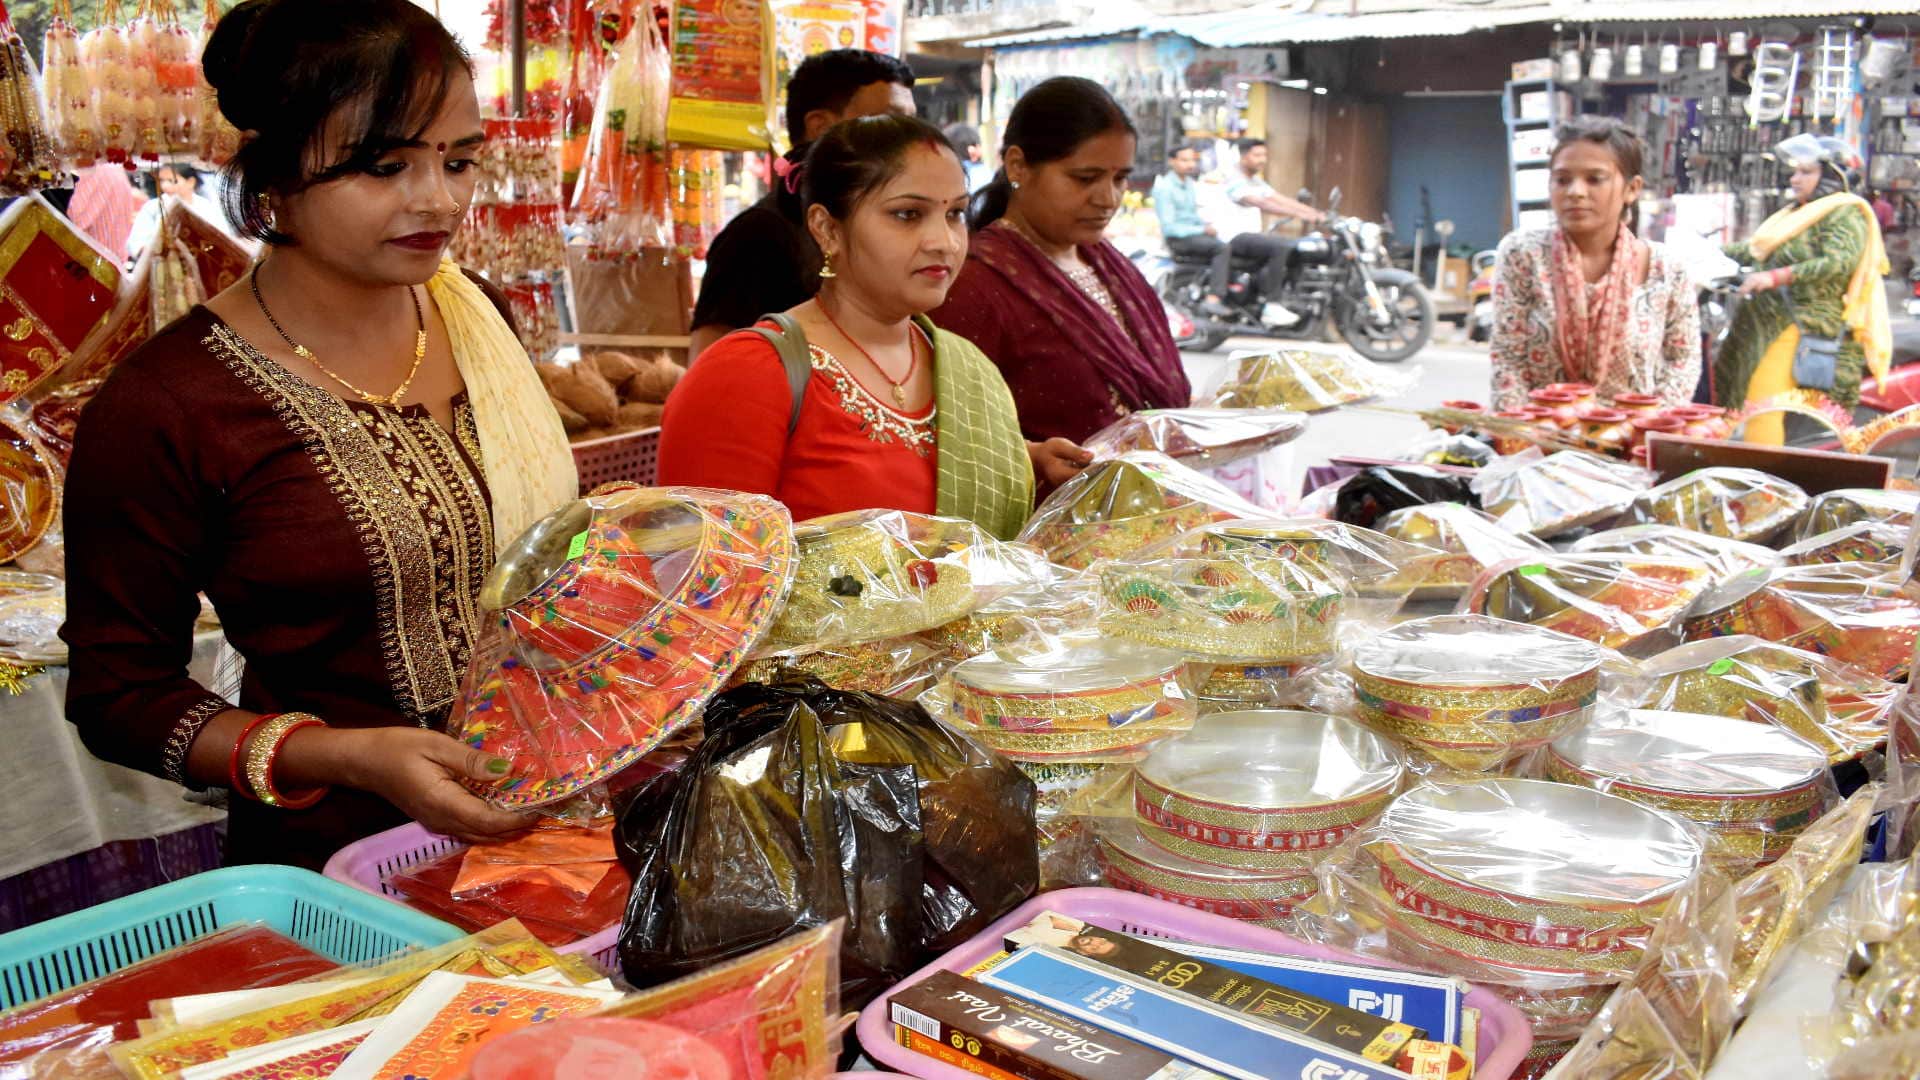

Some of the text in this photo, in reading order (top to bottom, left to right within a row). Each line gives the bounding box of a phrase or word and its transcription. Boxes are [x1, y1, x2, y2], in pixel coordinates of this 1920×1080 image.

[944, 990, 1007, 1021] Vasi
[1286, 1001, 1323, 1021] Zed
[1011, 1016, 1121, 1063] Bharat
